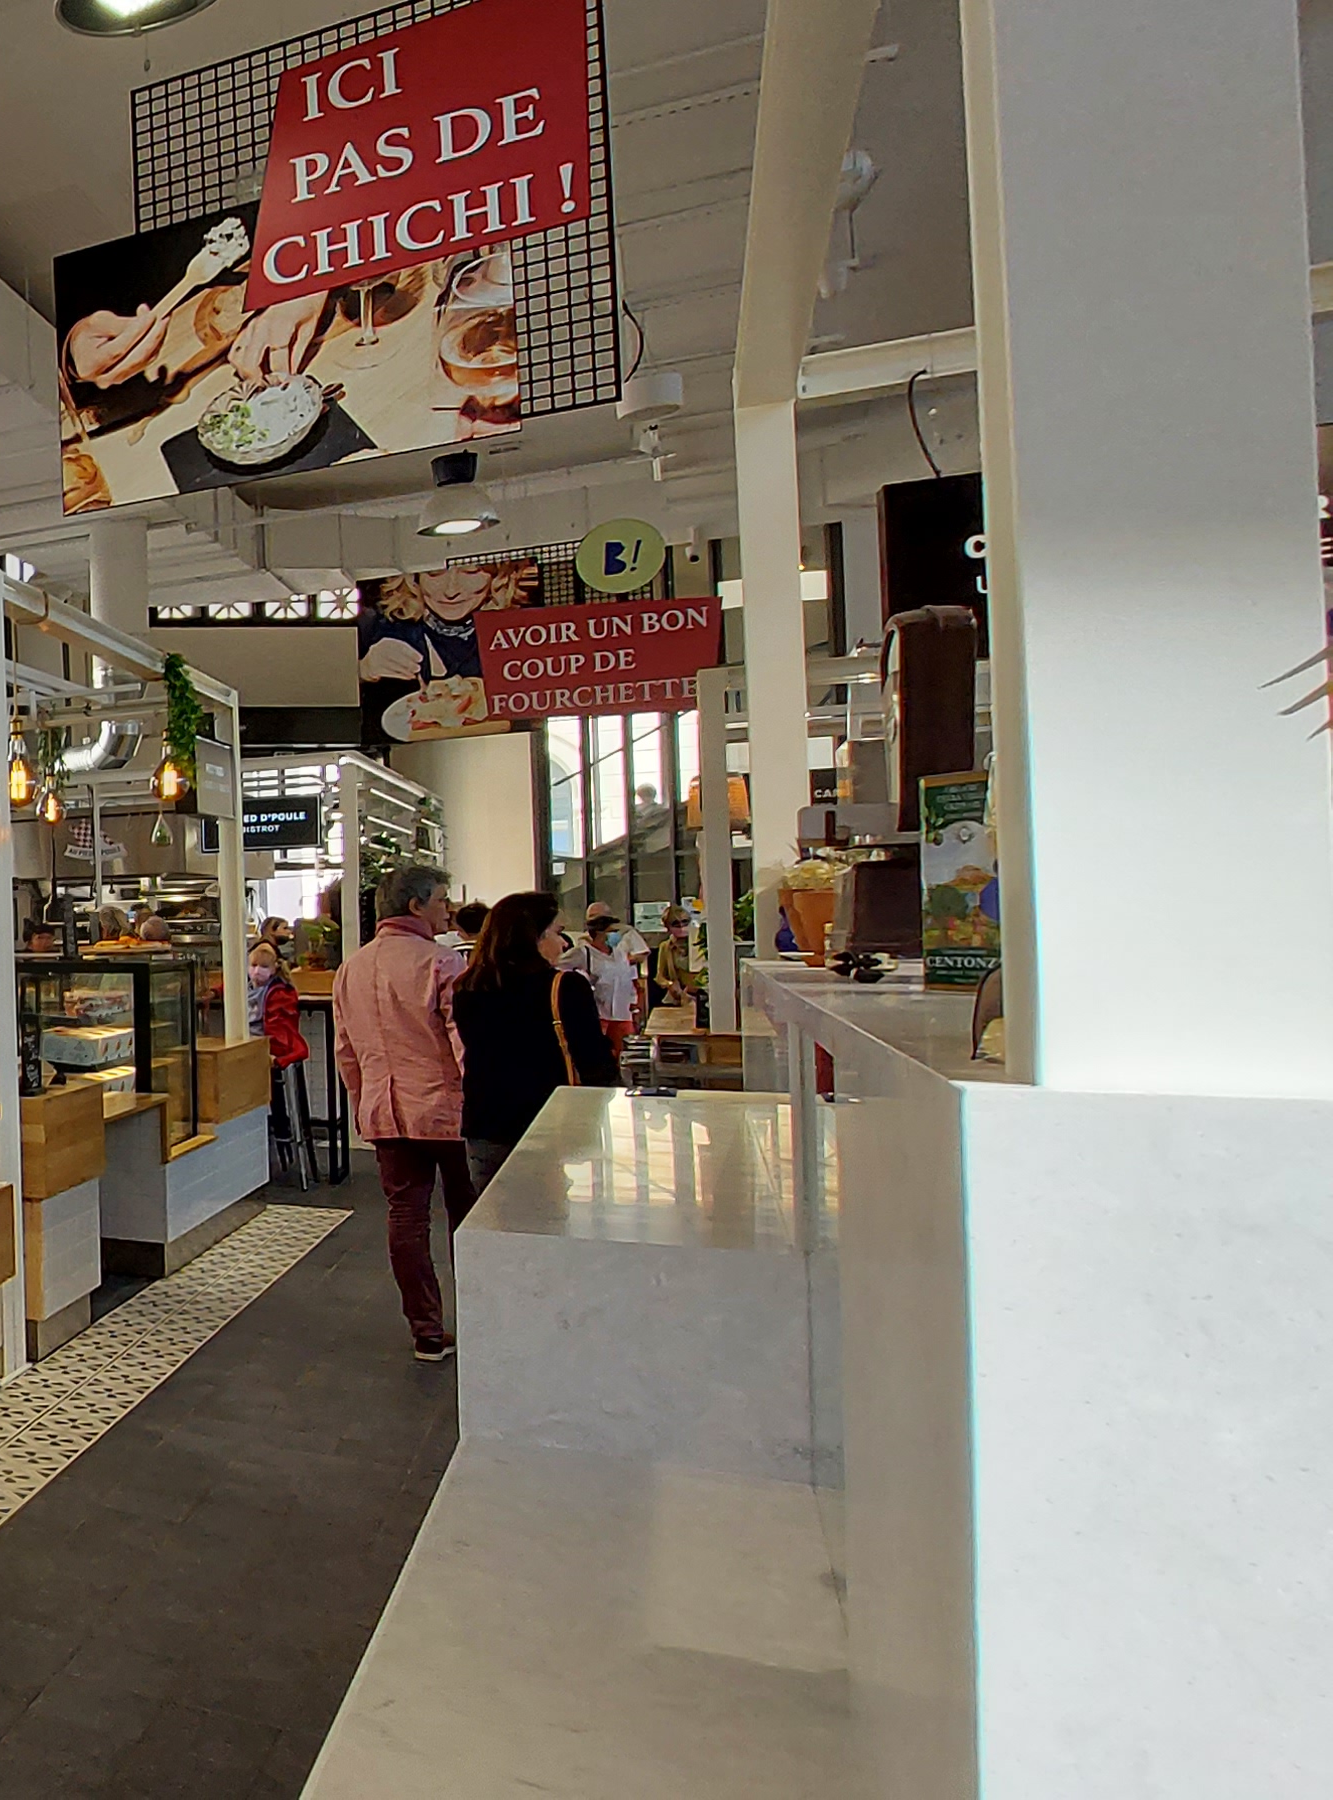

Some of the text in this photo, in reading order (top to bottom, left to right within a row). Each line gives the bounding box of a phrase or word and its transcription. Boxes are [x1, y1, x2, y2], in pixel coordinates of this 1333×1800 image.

[300, 46, 403, 123] ICI
[288, 87, 547, 204] PAS DE
[261, 173, 537, 286] CHICHI
[604, 538, 642, 577] B!
[489, 605, 710, 651] AVOIR UN BON
[502, 648, 637, 682] COUP DE
[491, 675, 698, 717] FOURCHETTE
[242, 813, 258, 823] ED
[925, 955, 999, 969] CENTONZ
